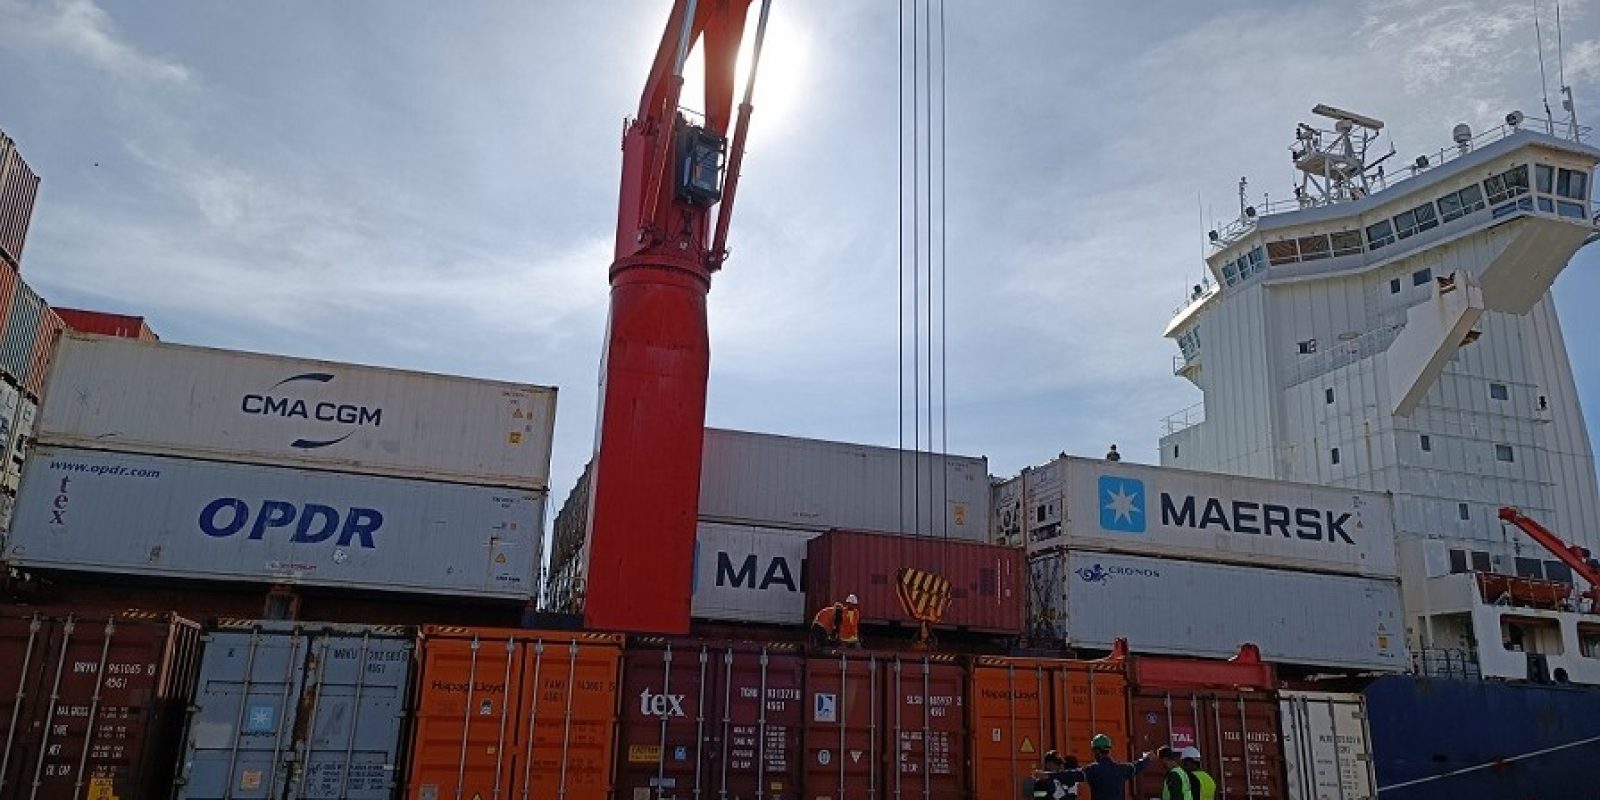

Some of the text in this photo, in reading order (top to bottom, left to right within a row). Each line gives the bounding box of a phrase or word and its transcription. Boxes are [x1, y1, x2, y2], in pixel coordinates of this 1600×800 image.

[242, 394, 382, 427] CMA CGM
[49, 461, 161, 478] www.opdr.com
[49, 475, 71, 525] tex
[198, 498, 385, 549] OPDR
[1160, 492, 1356, 545] MAERSK
[715, 551, 807, 593] MA
[1108, 565, 1160, 577] CRONOS
[432, 680, 506, 695] HapagLloyd
[640, 687, 686, 717] tex
[1171, 733, 1194, 742] TAL
